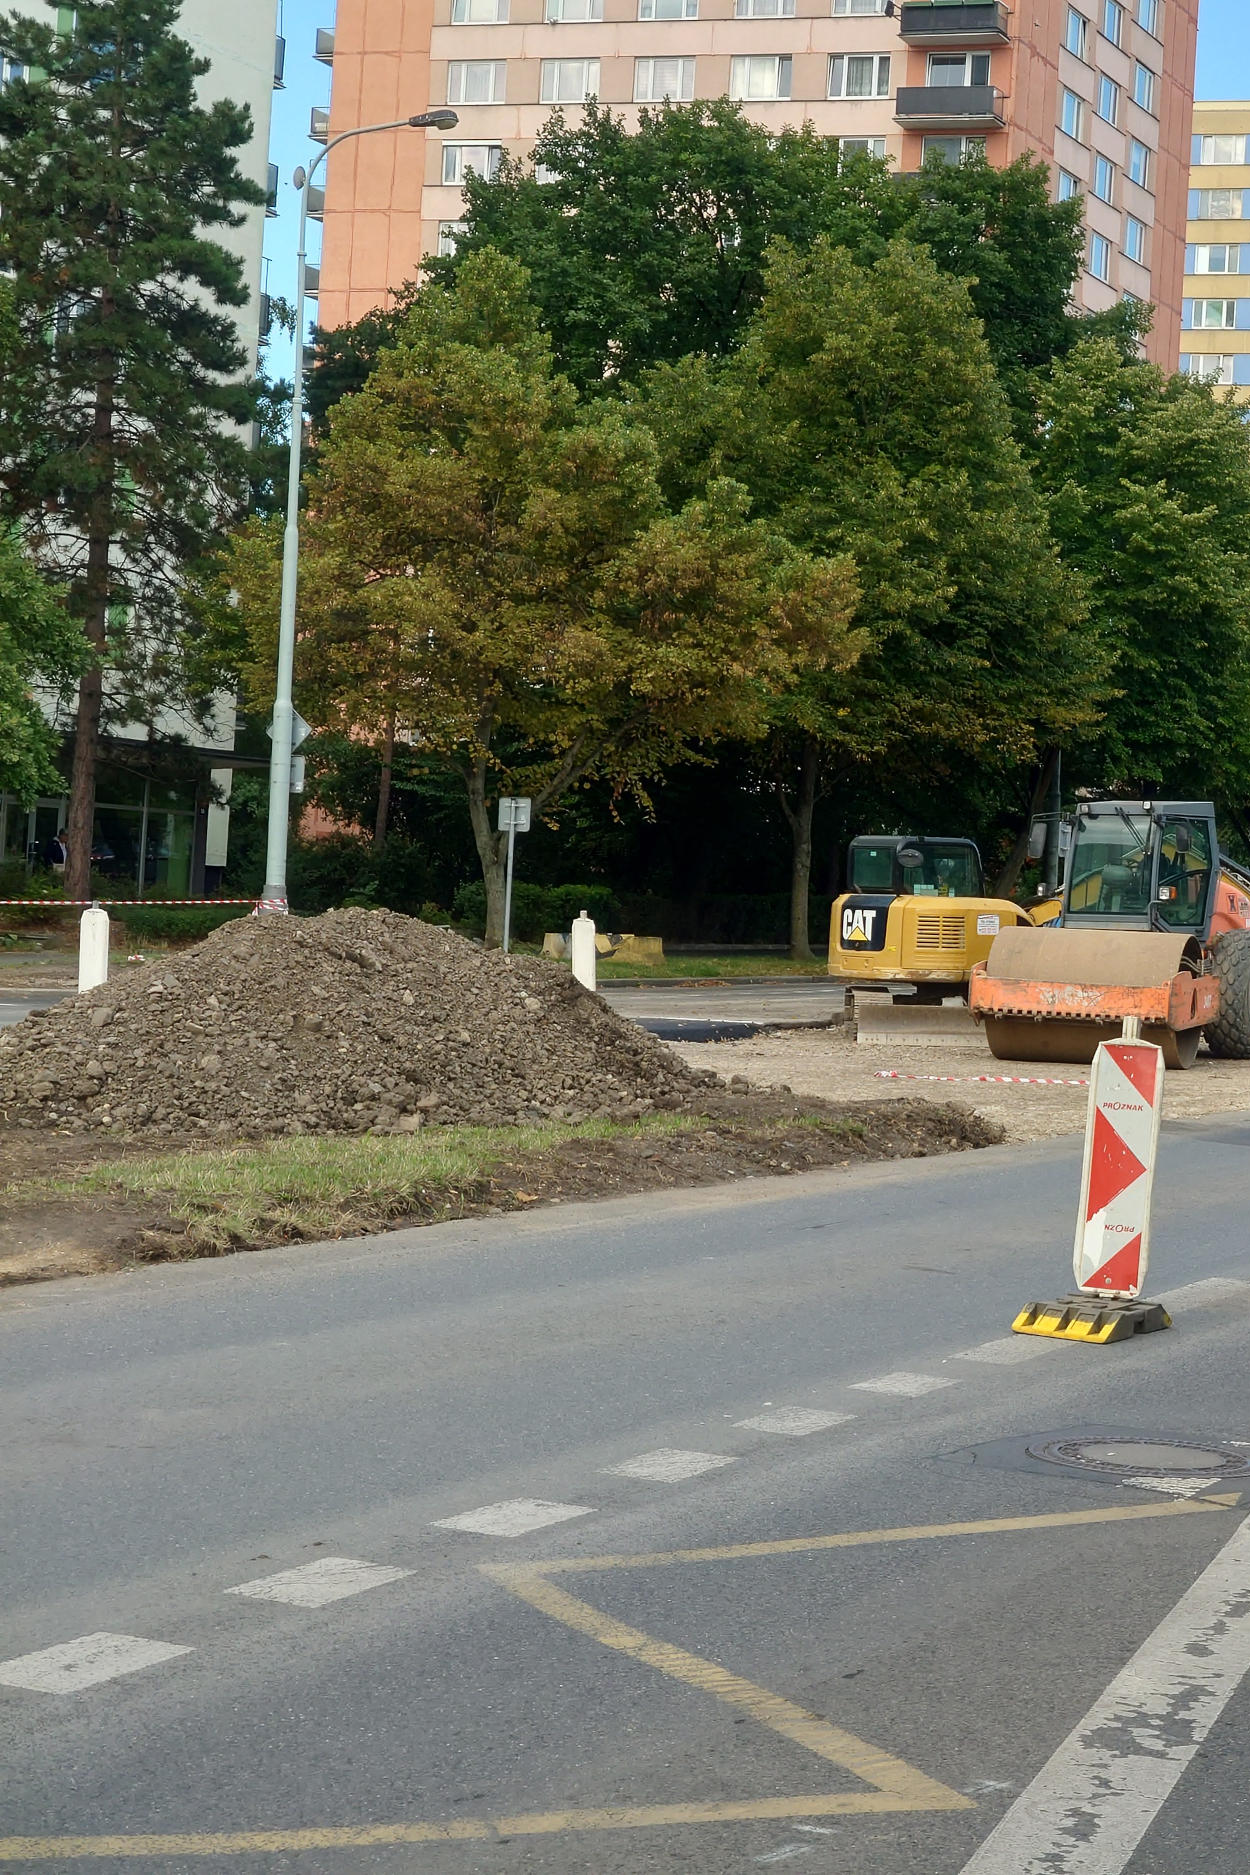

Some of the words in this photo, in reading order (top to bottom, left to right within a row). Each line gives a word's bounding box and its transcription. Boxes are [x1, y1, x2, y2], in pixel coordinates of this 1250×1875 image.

[842, 908, 876, 941] CAT
[1102, 1101, 1144, 1111] PROZNAK
[1104, 1224, 1135, 1232] PROZN
